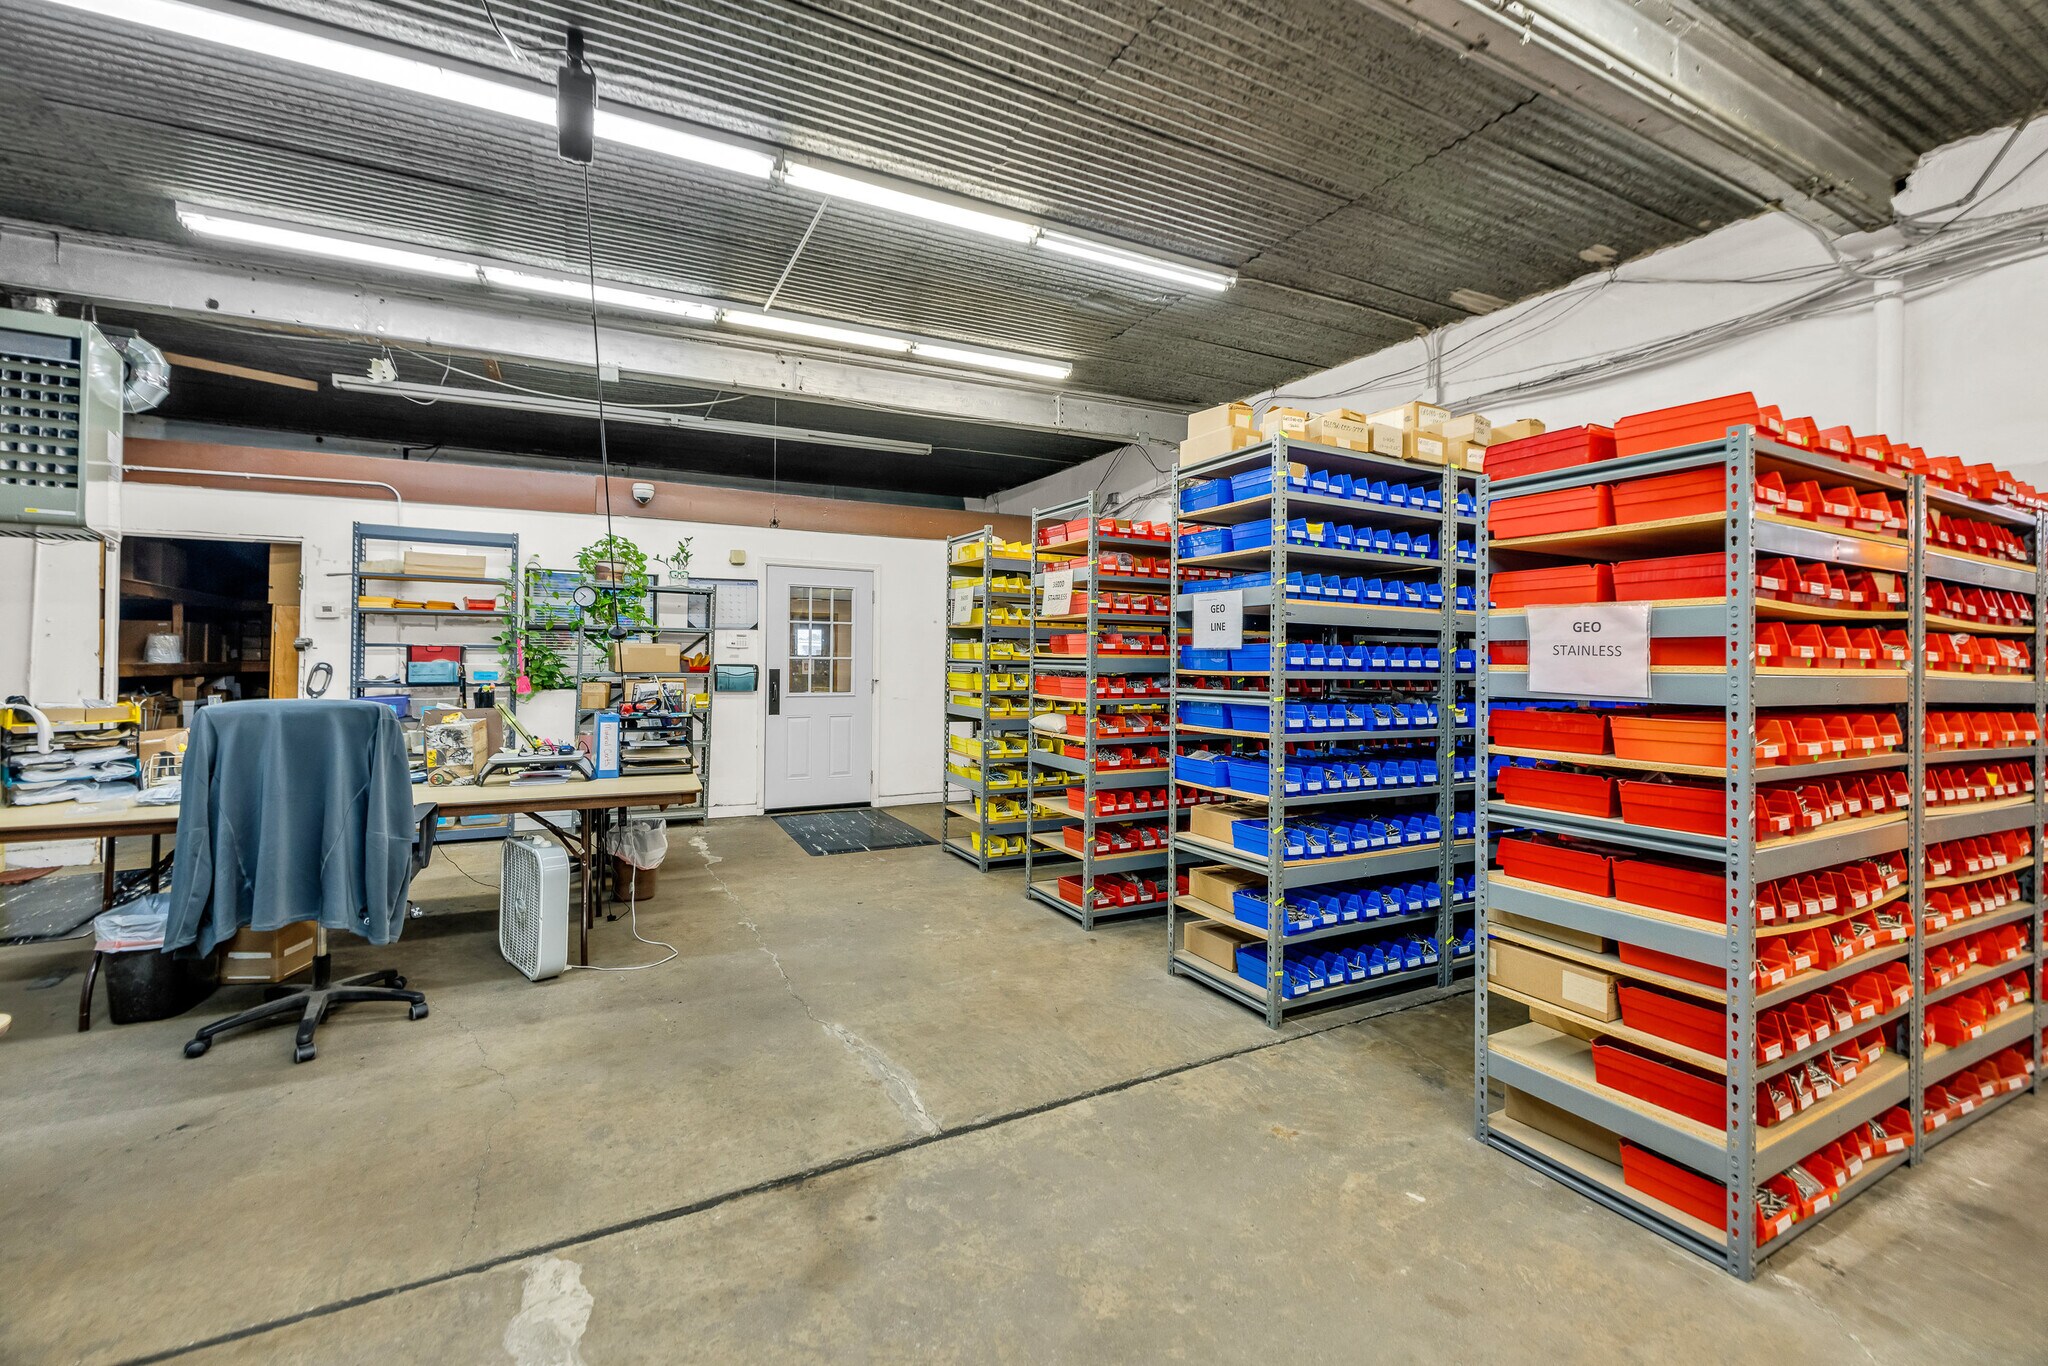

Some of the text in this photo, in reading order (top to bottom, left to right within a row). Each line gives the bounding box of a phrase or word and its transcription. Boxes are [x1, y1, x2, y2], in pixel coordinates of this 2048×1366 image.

[1210, 604, 1226, 613] GEO
[1210, 622, 1226, 631] LINE
[1572, 622, 1602, 632] GEO
[1552, 644, 1622, 656] STAINLESS
